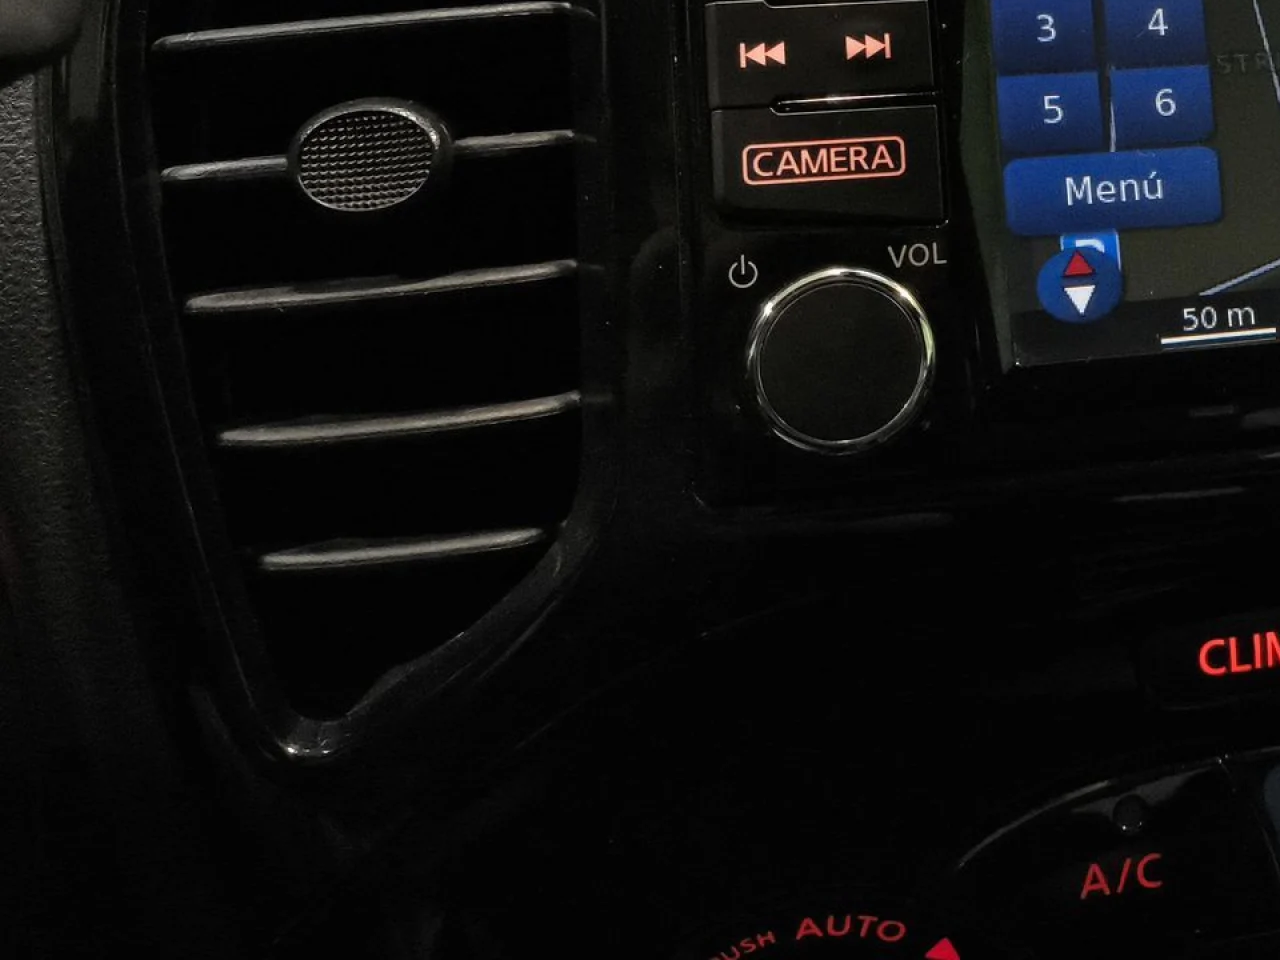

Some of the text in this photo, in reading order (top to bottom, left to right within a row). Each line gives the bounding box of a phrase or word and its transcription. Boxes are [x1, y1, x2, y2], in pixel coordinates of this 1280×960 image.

[1037, 14, 1057, 42] 3
[1148, 8, 1169, 36] 4
[1043, 95, 1064, 124] 5
[1155, 88, 1176, 117] 6
[752, 144, 895, 177] CAMERA
[1065, 170, 1164, 206] Menú
[887, 242, 948, 268] VOL
[1182, 306, 1256, 332] 50 m
[1080, 853, 1164, 899] A/C
[795, 915, 907, 942] AUTO
